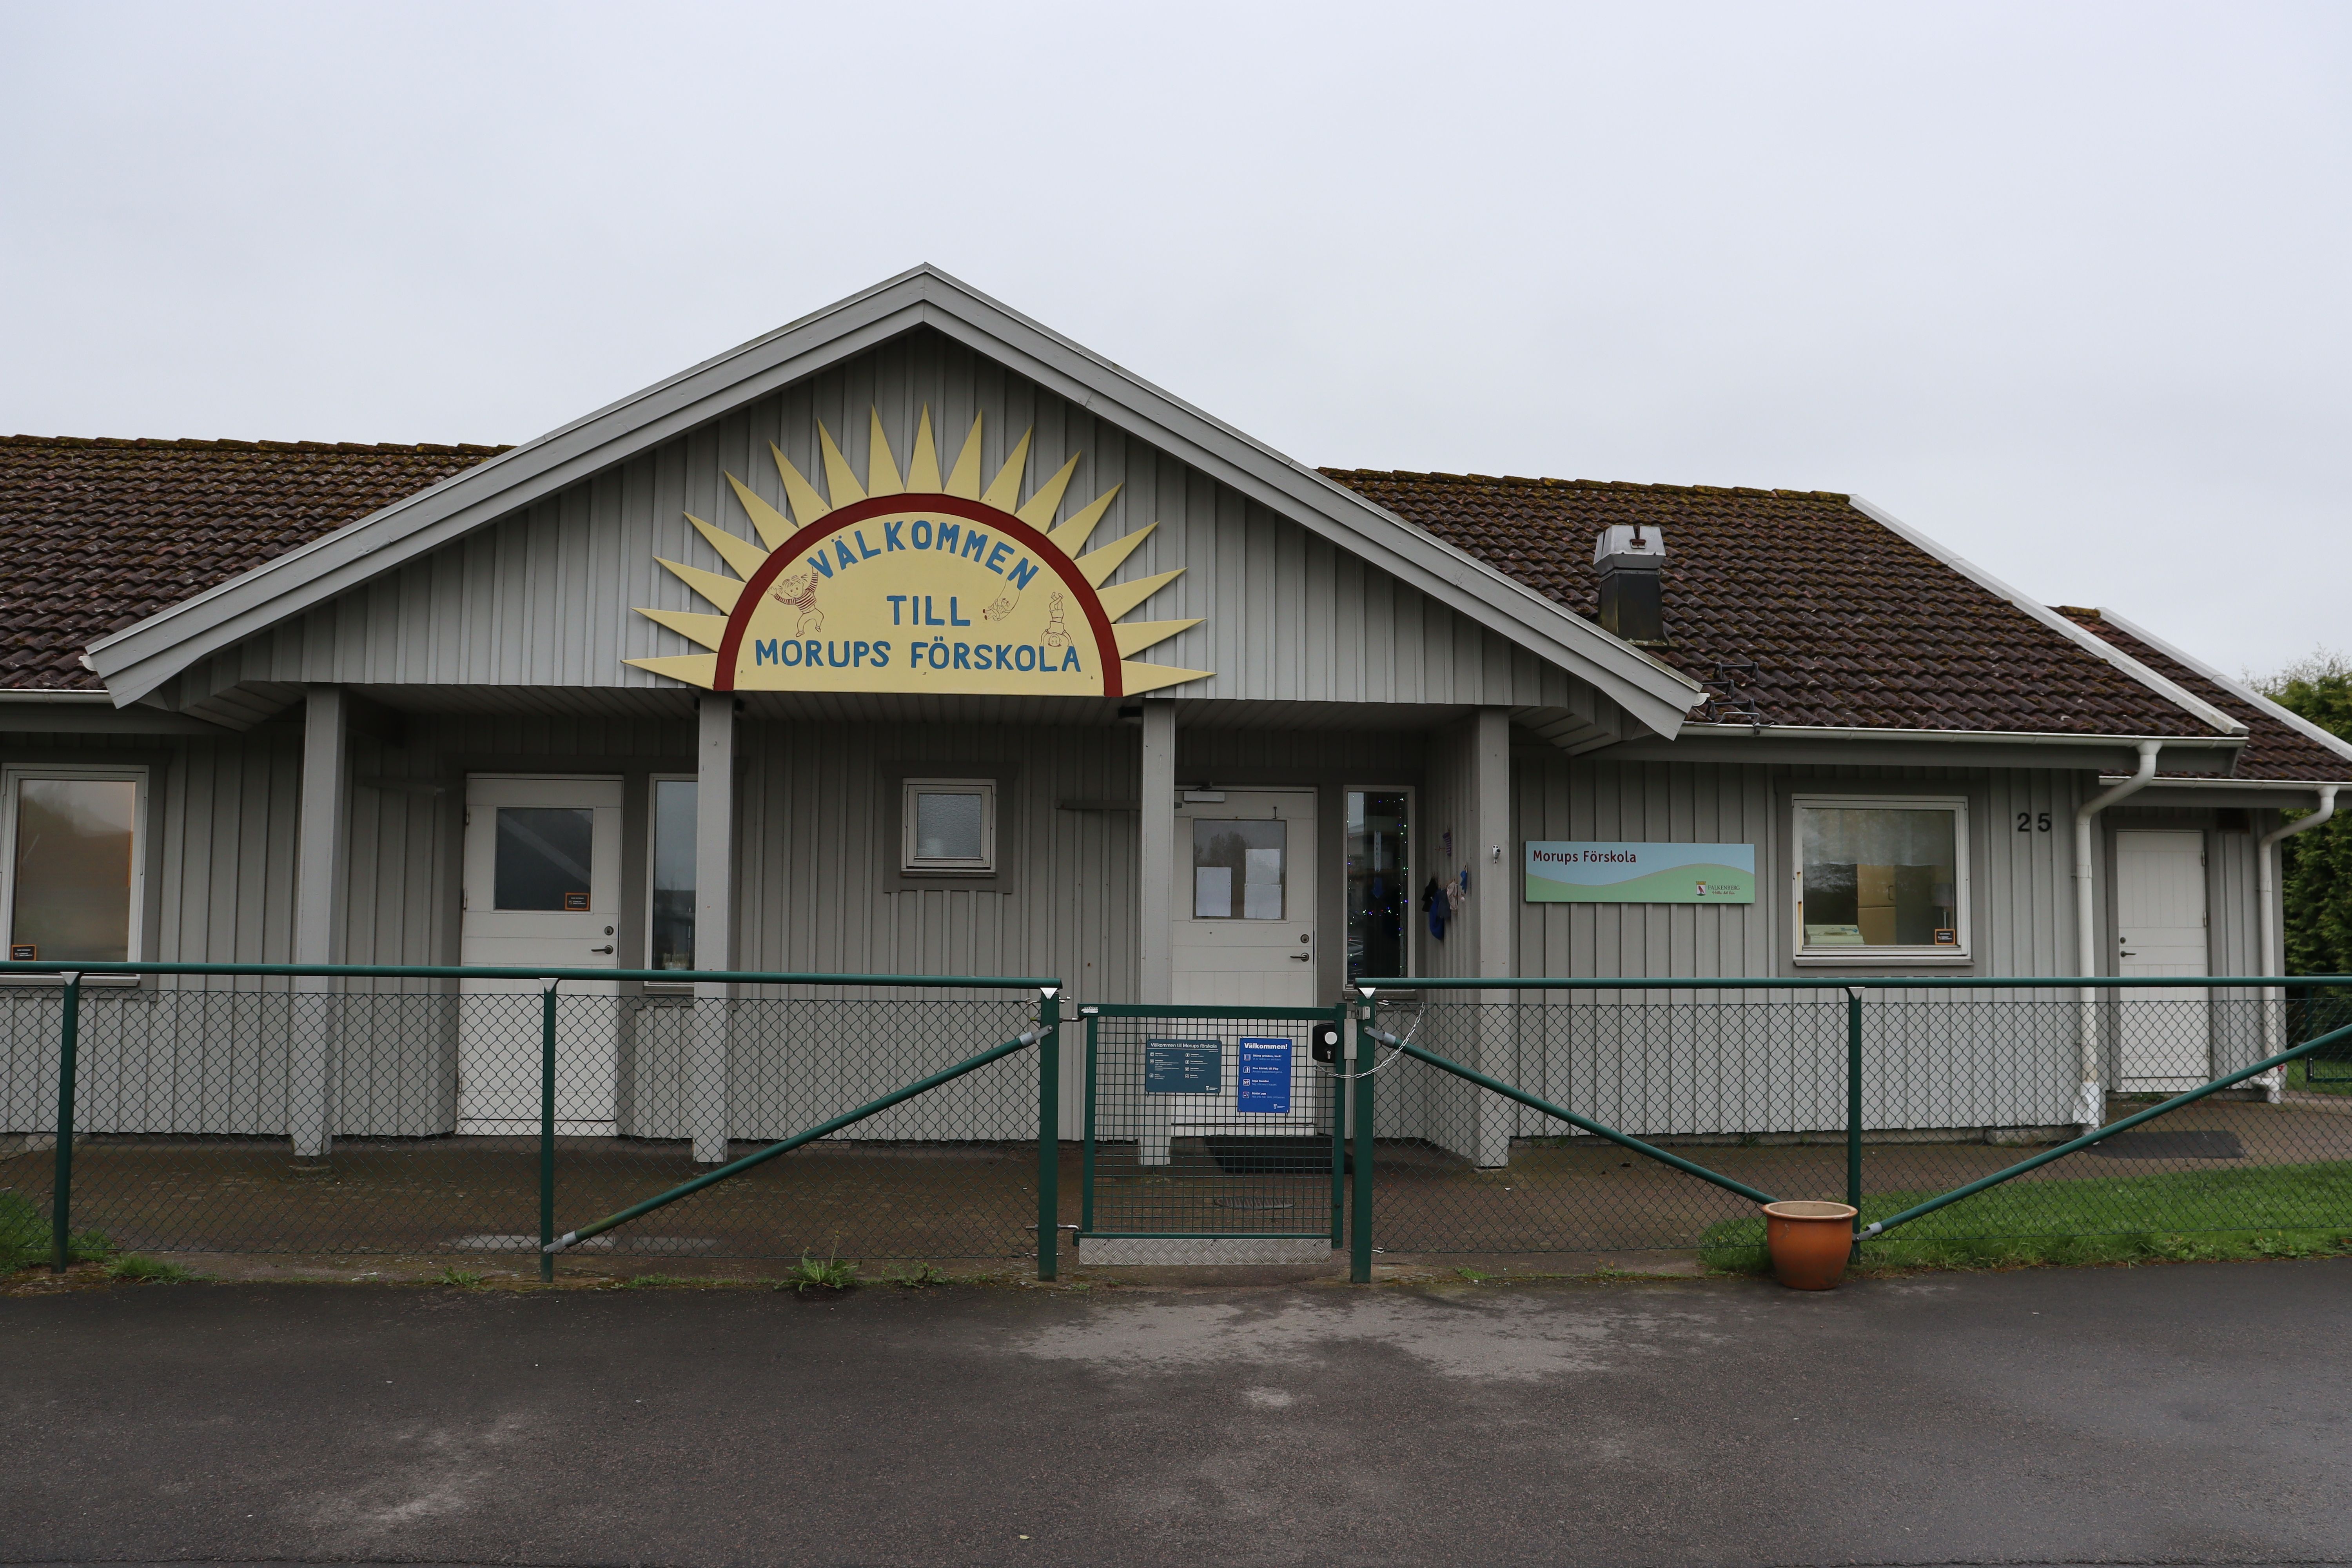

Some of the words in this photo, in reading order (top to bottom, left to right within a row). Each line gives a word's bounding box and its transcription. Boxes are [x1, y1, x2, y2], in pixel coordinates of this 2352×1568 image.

[806, 519, 1040, 591] VÄLKOMMEN
[886, 595, 971, 626] TILL
[755, 638, 891, 668] MORUPS
[911, 635, 1082, 673] FÖRSKOLA
[2017, 812, 2052, 833] 25
[1533, 850, 1578, 865] Morups
[1583, 850, 1637, 863] Förskola
